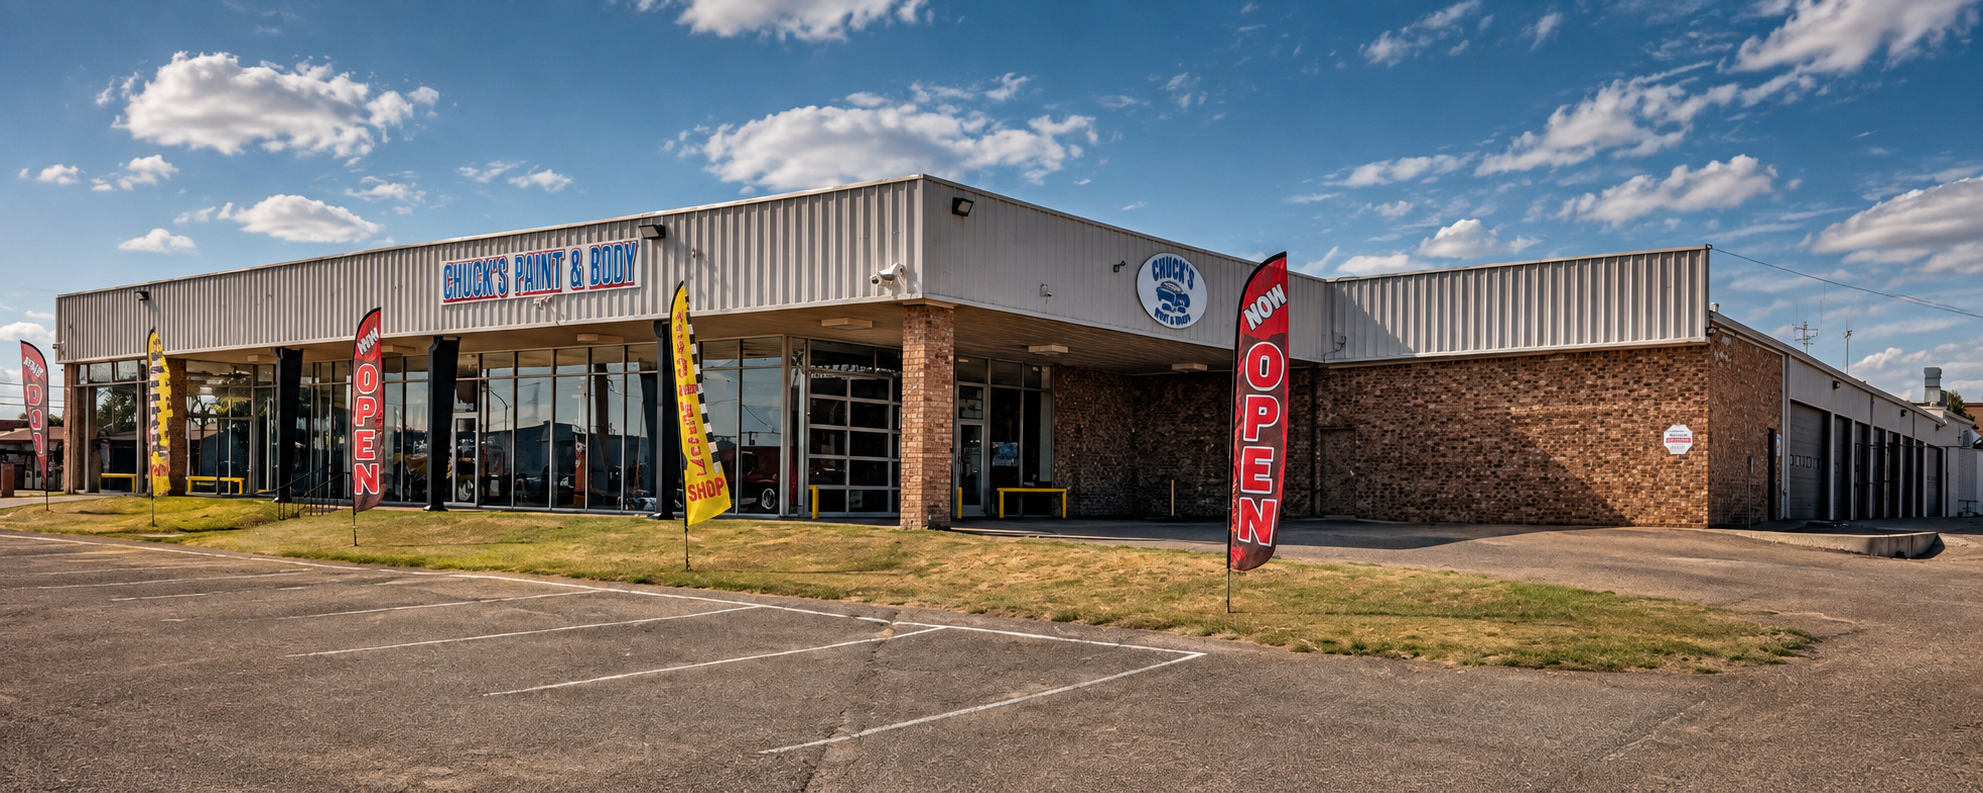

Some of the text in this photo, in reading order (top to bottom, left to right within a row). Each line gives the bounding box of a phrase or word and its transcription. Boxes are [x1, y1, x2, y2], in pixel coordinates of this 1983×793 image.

[443, 240, 639, 303] CHUCK'S PAINT & BODY
[1152, 256, 1195, 290] CHUCK'S
[1243, 283, 1287, 331] NOW
[354, 363, 379, 495] OPEN
[1238, 341, 1285, 547] OPEN
[688, 477, 725, 502] SHOP
